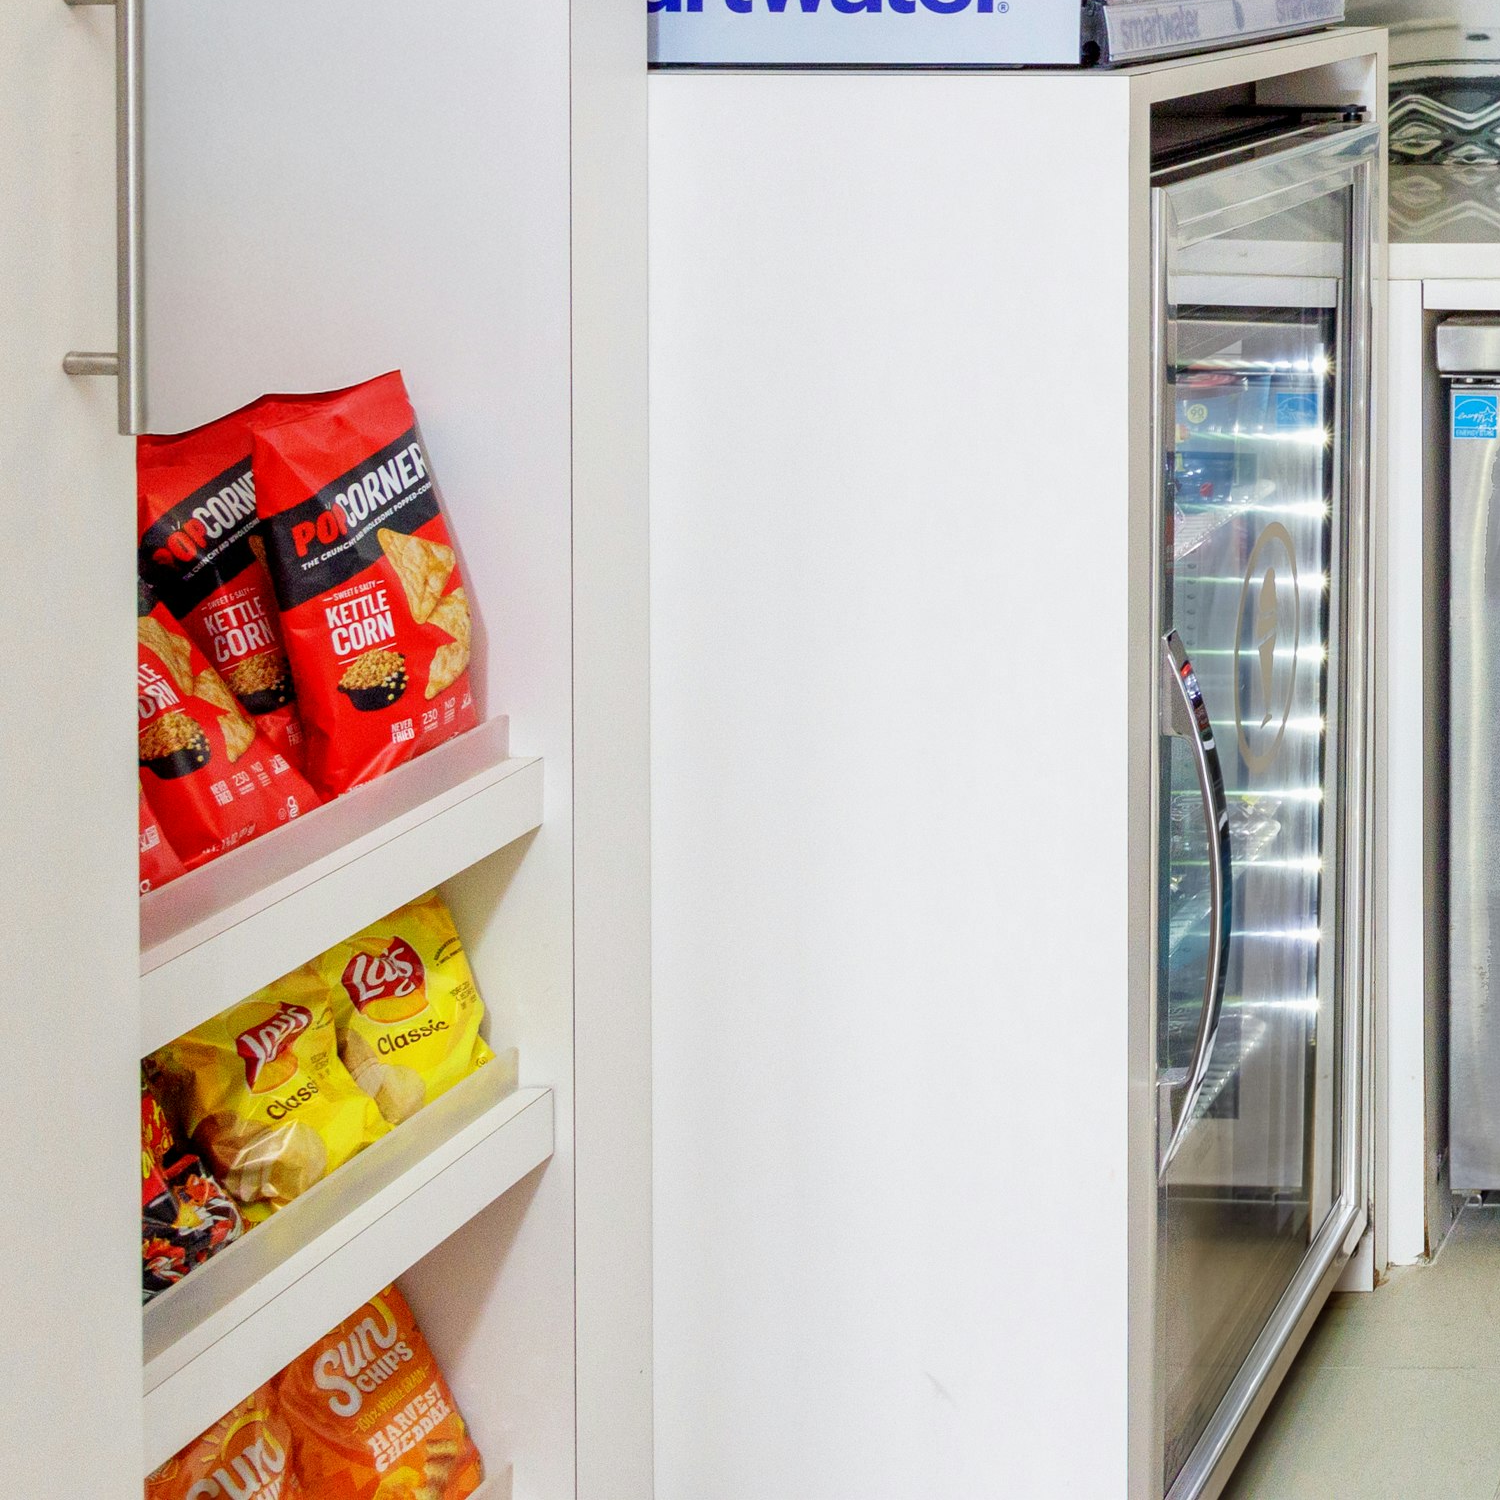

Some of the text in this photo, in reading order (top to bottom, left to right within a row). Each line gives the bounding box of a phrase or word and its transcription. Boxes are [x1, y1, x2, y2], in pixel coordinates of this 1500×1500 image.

[291, 442, 427, 557] POPCORNER
[302, 509, 394, 571] THE CRUNCHY WHOLESOME
[325, 589, 390, 629] KETTLE
[333, 581, 377, 601] SWEET SALTY
[204, 596, 266, 636] KETTLE
[331, 611, 396, 656] CORN
[214, 617, 275, 663] CORN
[422, 708, 438, 725] 230
[444, 698, 456, 710] NO
[391, 718, 413, 733] NEVER
[392, 728, 415, 744] FRIED
[232, 770, 250, 787] 230
[377, 1018, 449, 1055] Classic
[312, 1310, 398, 1418] Sun
[356, 1340, 414, 1393] CHIPS
[368, 1381, 442, 1456] HARVEST
